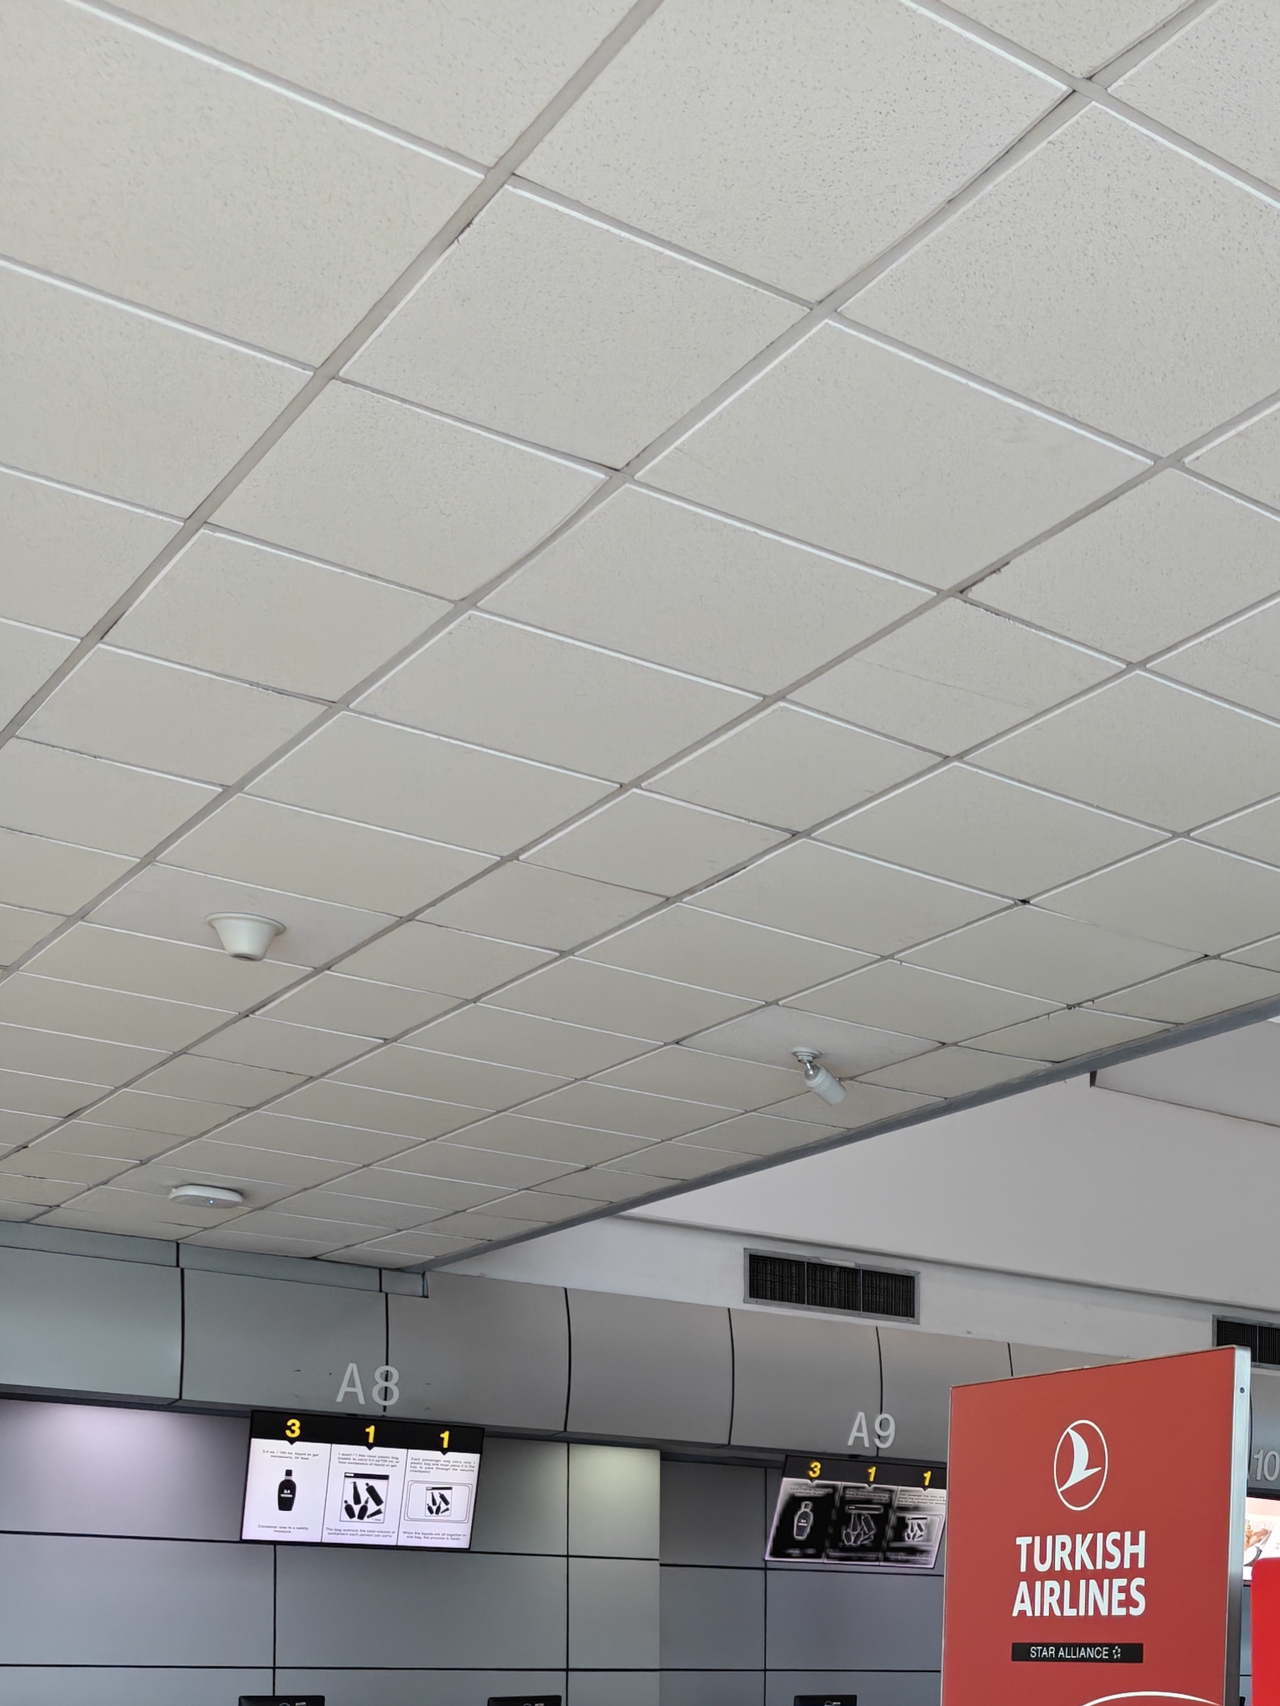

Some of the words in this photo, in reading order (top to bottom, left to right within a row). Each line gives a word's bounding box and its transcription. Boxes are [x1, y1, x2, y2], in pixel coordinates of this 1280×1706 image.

[336, 1362, 400, 1406] A8
[285, 1419, 301, 1438] 3
[365, 1425, 376, 1443] 1
[440, 1431, 450, 1449] 1
[847, 1411, 896, 1449] A9
[808, 1461, 822, 1478] 3
[868, 1466, 877, 1482] 1
[923, 1470, 932, 1486] 1
[1253, 1450, 1280, 1482] 10
[1016, 1530, 1146, 1572] TURKISH
[1012, 1577, 1146, 1617] AIRLINES
[1030, 1646, 1055, 1658] STAR
[1058, 1646, 1109, 1659] ALLIANCE
